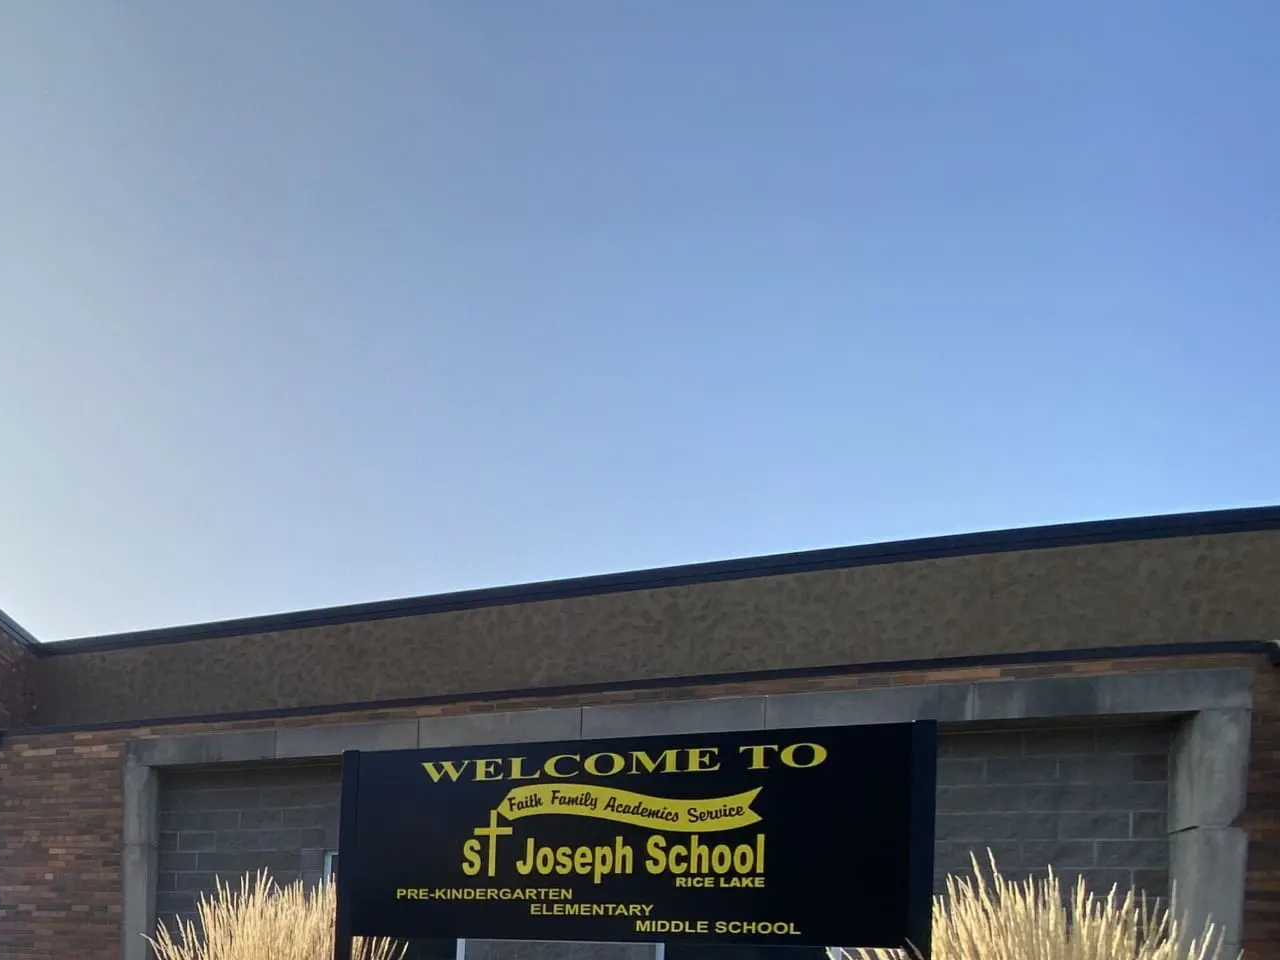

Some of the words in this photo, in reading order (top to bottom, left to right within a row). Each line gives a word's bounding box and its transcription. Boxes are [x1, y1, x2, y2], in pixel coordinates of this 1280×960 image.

[421, 748, 721, 784] WELCOME
[739, 743, 828, 770] TO
[507, 794, 543, 813] Faith
[550, 789, 598, 811] Family
[604, 797, 679, 823] Academics
[687, 805, 745, 823] Service
[516, 836, 634, 885] Joseph
[645, 833, 766, 875] School
[675, 876, 715, 888] RICE
[719, 876, 766, 888] LAKE
[396, 888, 573, 900] PRE-KINDERGARTEN
[530, 903, 655, 916] ELEMENTARY
[635, 919, 709, 933] MIDDLE
[714, 920, 802, 935] SCHOOL
